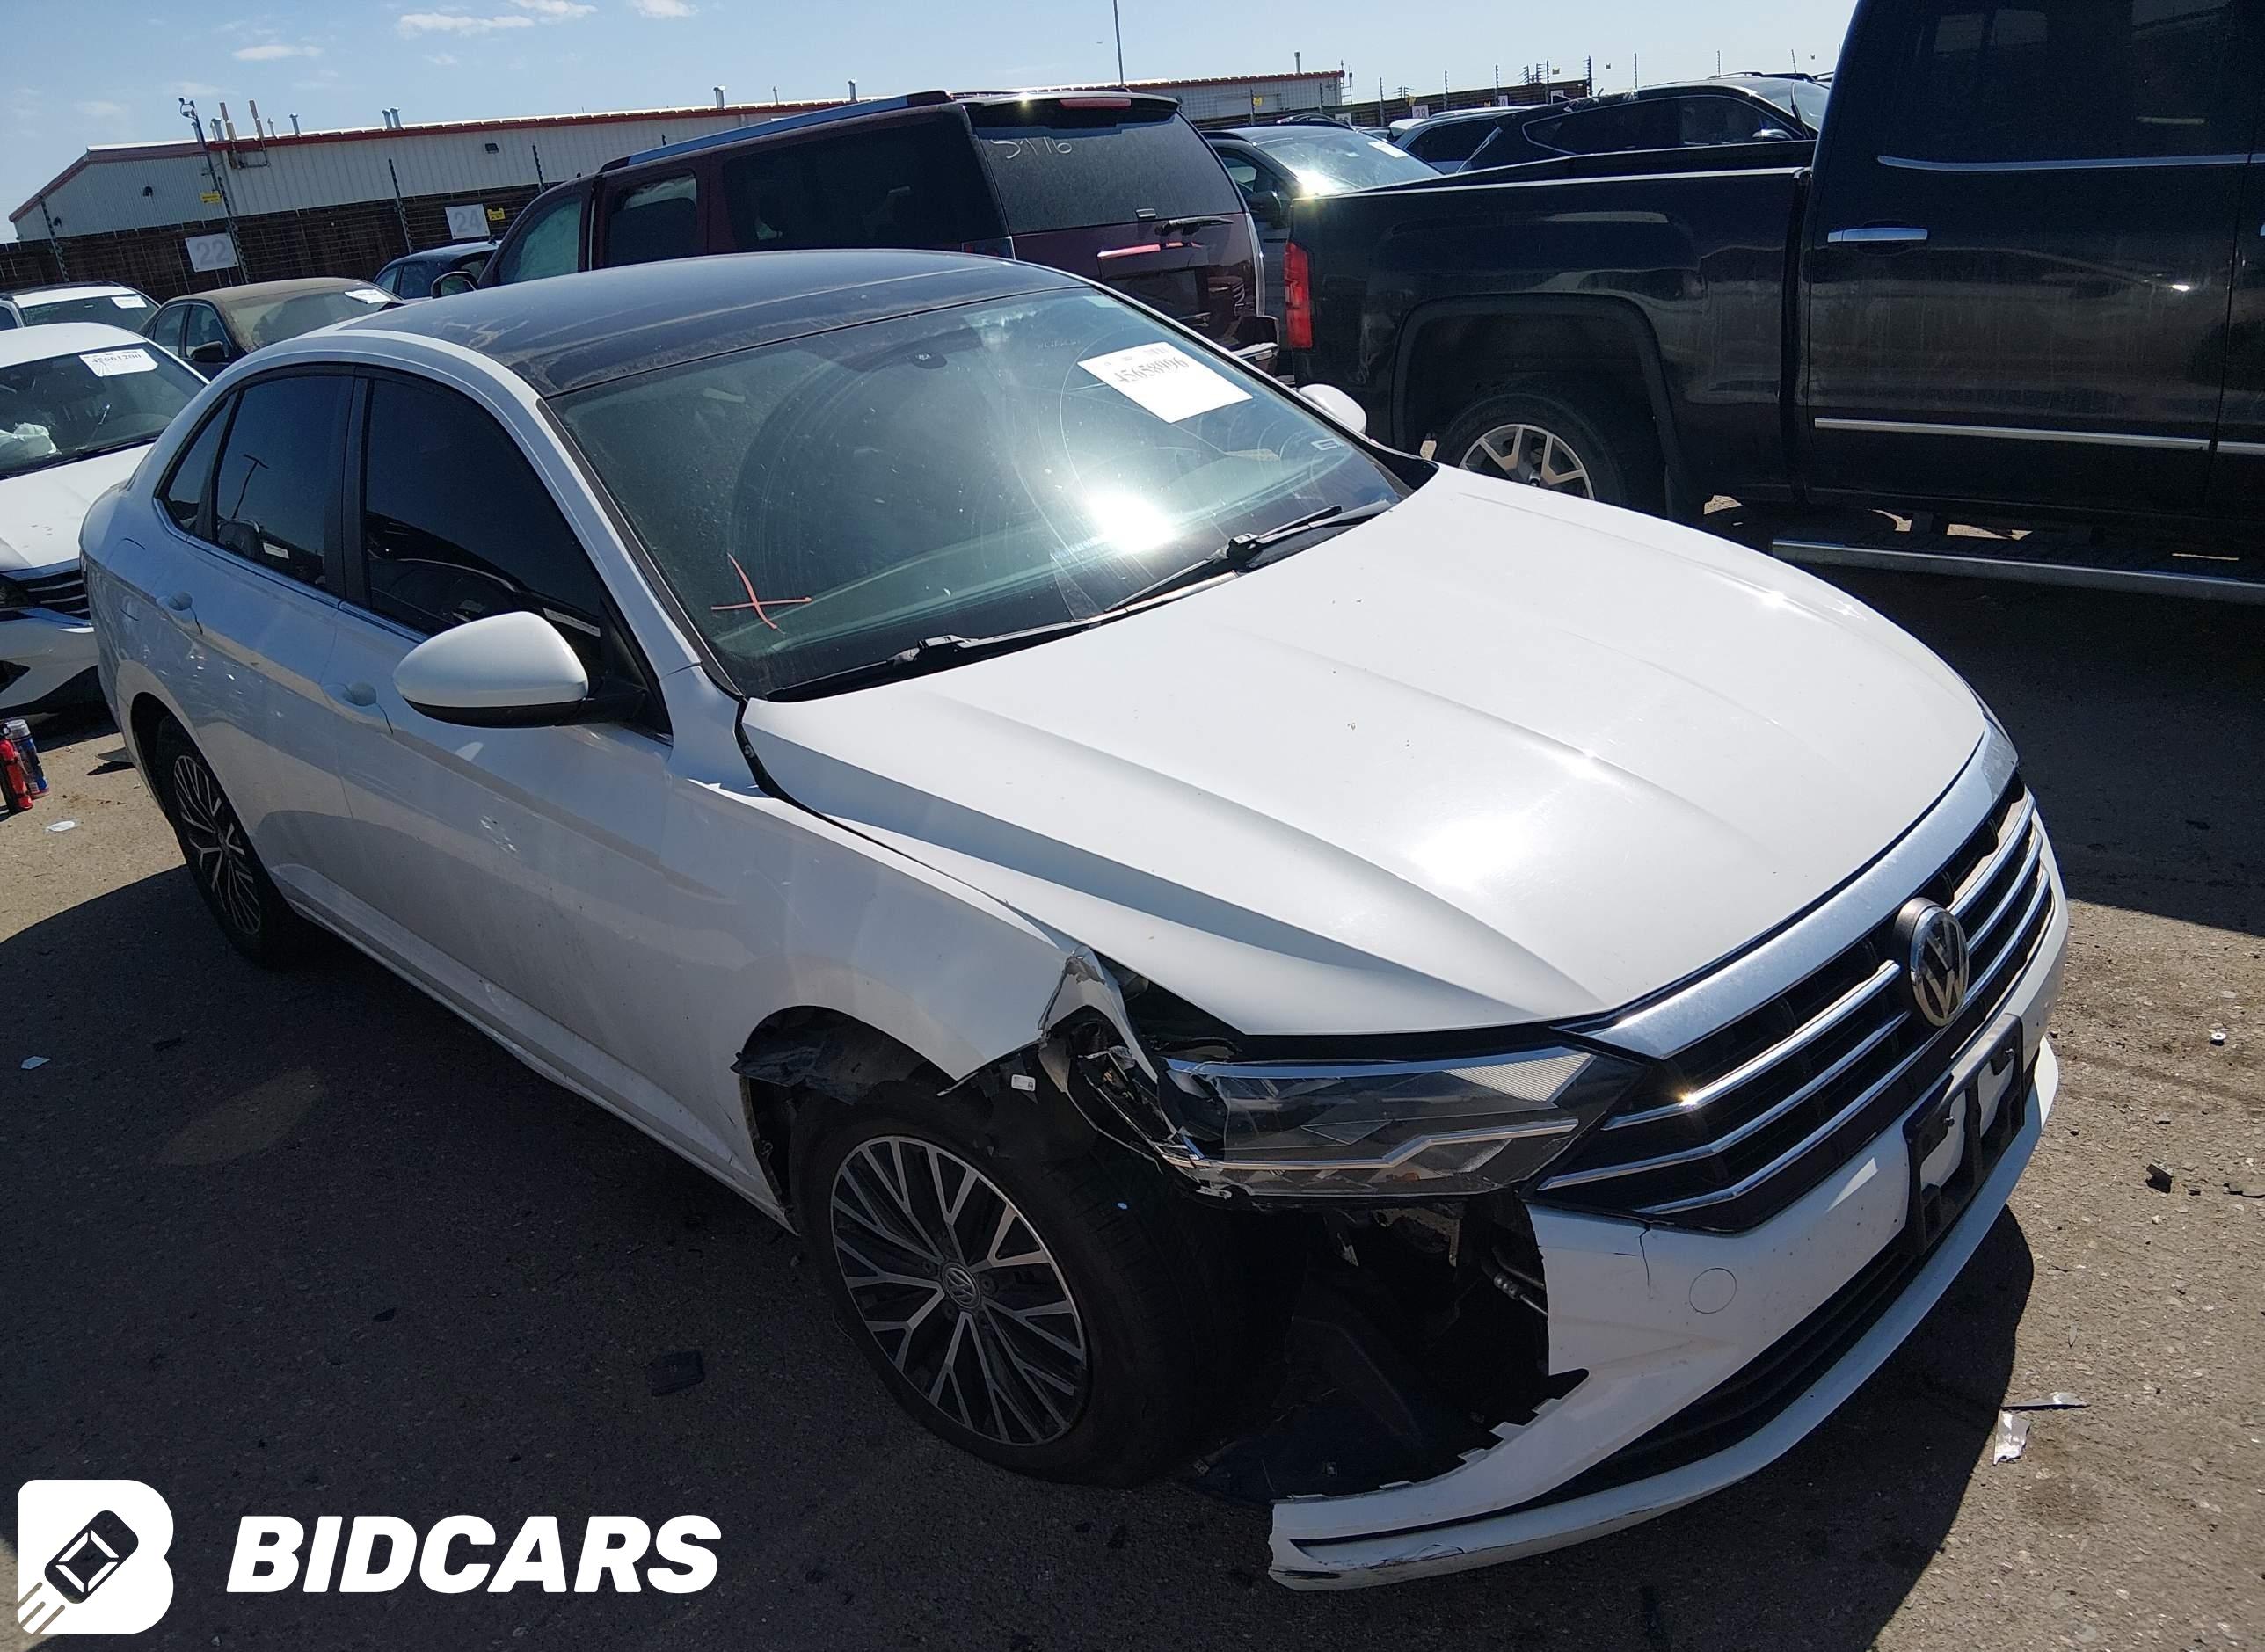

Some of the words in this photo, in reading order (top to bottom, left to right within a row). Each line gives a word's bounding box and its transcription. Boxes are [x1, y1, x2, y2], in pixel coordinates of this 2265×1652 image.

[454, 209, 482, 233] 24
[197, 239, 229, 266] 22
[1114, 357, 1190, 382] 45658996
